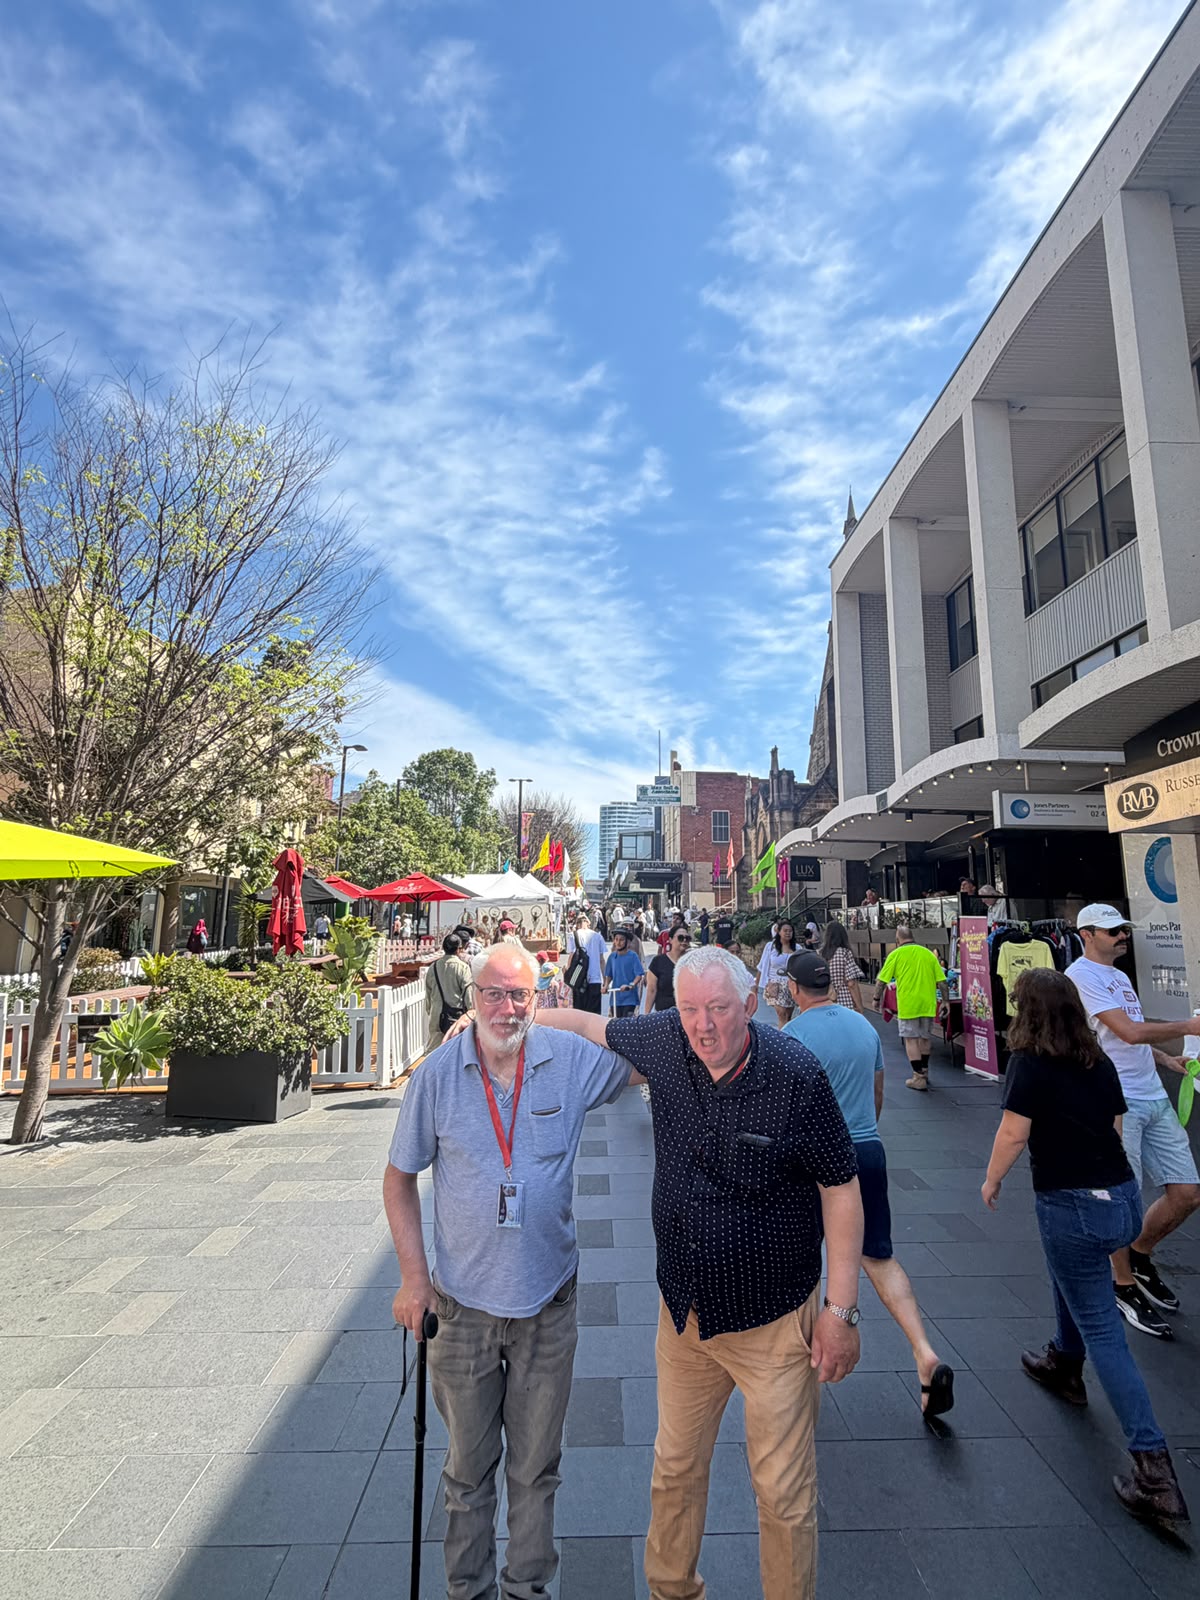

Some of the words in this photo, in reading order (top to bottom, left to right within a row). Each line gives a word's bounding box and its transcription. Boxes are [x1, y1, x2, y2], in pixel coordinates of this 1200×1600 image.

[1165, 773, 1200, 793] RUSSE
[1121, 786, 1156, 813] RMB
[795, 864, 815, 875] LUX
[1149, 922, 1169, 933] Jones
[1169, 922, 1181, 931] Par
